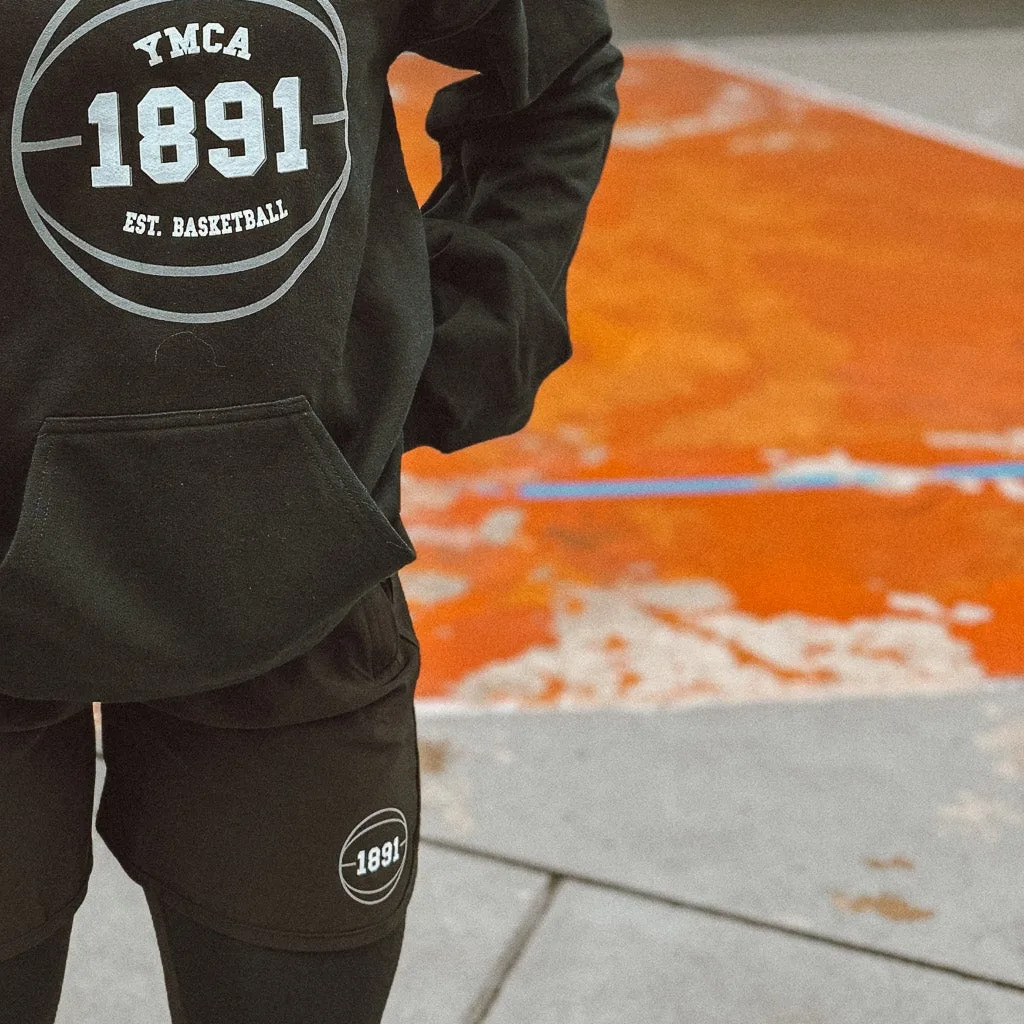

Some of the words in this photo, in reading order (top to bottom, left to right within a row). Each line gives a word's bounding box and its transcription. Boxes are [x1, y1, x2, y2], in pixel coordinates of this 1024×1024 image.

[133, 22, 252, 67] YMCA
[87, 76, 308, 188] 1891
[123, 211, 162, 236] EST.
[172, 199, 289, 237] BASKETBALL
[357, 836, 400, 876] 1891
